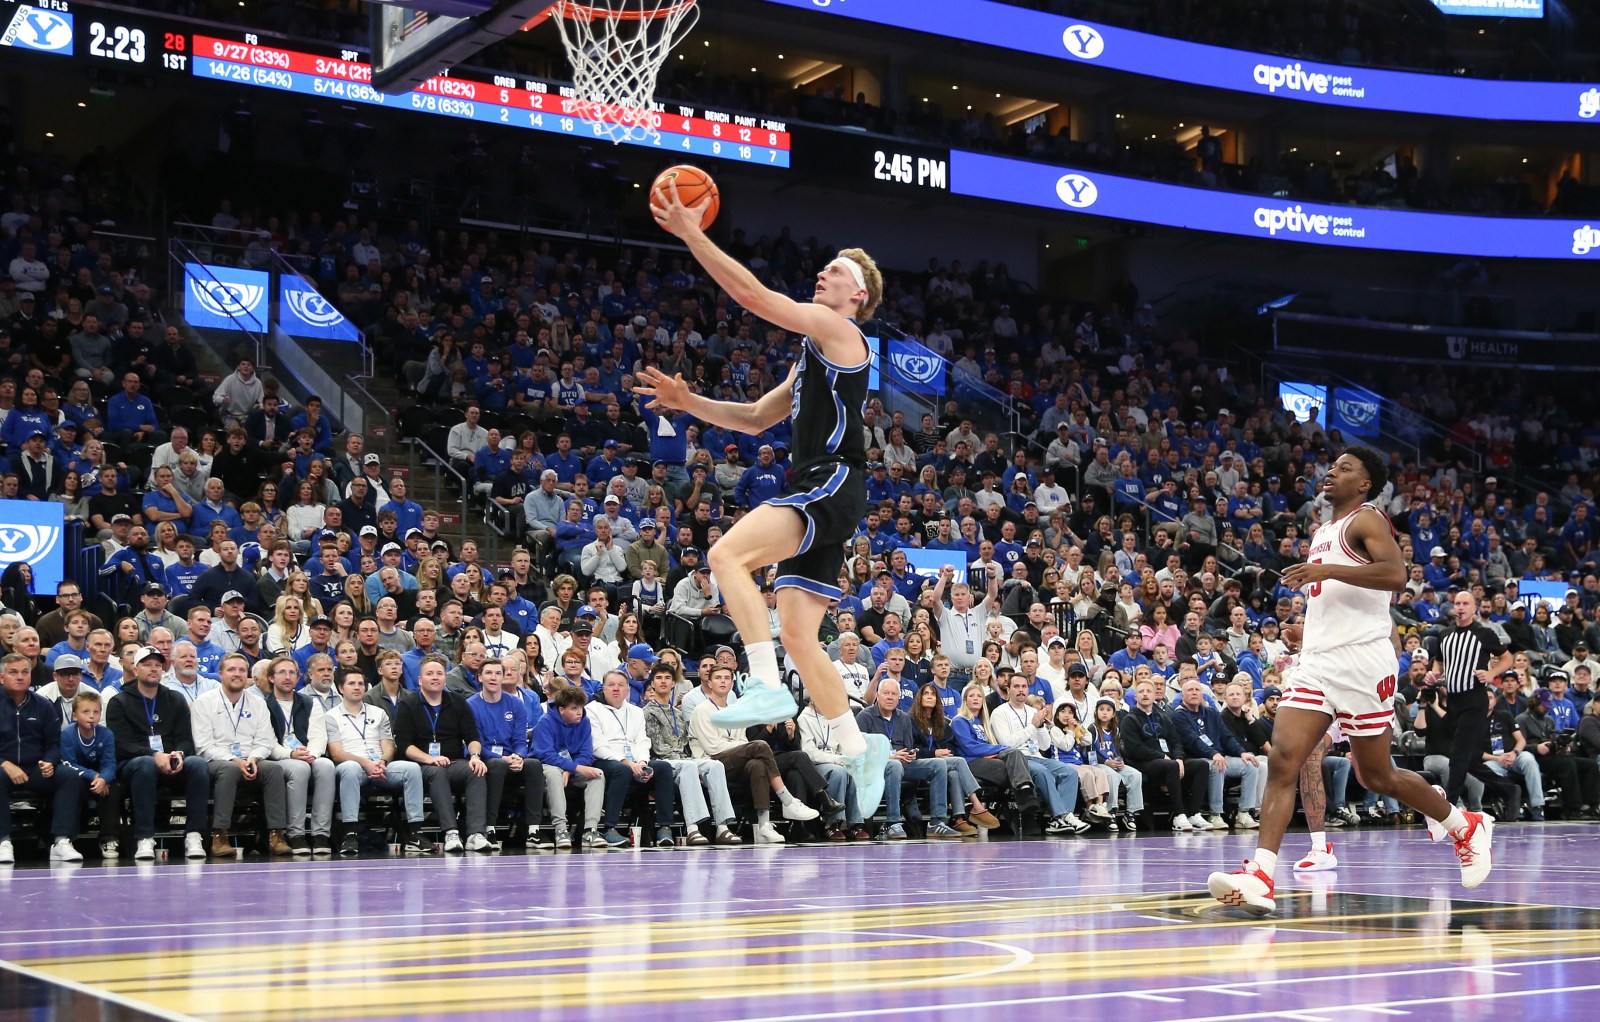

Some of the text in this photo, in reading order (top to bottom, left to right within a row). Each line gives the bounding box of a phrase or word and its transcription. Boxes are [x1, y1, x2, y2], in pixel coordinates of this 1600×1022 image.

[51, 0, 69, 12] FLS
[5, 8, 28, 43] BONUS
[90, 22, 146, 63] 2:23
[245, 33, 258, 46] FG
[163, 53, 187, 70] 1ST
[213, 42, 290, 69] 9/27 (33%)
[341, 50, 358, 62] 3PT
[209, 61, 293, 90] 14/26 (54%)
[315, 59, 346, 76] 3/14
[494, 75, 516, 89] OREB
[1253, 62, 1353, 94] aptive pest
[314, 78, 344, 96] 5/14
[439, 79, 476, 99] (82%)
[525, 80, 548, 94] DREB
[560, 86, 575, 98] REB
[1332, 87, 1365, 98] control
[411, 94, 475, 118] 5/8 (63%)
[679, 106, 694, 118] TOV
[500, 90, 509, 103] 5
[529, 95, 543, 109] 12
[682, 119, 691, 132] 4
[713, 124, 721, 137] 8
[739, 128, 751, 142] 12
[769, 133, 777, 146] 8
[705, 110, 730, 124] BENCH
[735, 115, 757, 128] PAINT
[760, 119, 786, 133] F-BREAK
[500, 108, 509, 122] 2
[529, 113, 543, 127] 14
[560, 118, 574, 132] 16
[653, 132, 662, 146] 2
[682, 137, 691, 151] 4
[713, 142, 721, 155] 9
[739, 146, 752, 160] 16
[769, 150, 777, 163] 7
[874, 151, 946, 189] 2:45 PM
[1253, 205, 1353, 236] aptive pest
[1333, 227, 1365, 238] control
[1470, 341, 1519, 356] HEALTH
